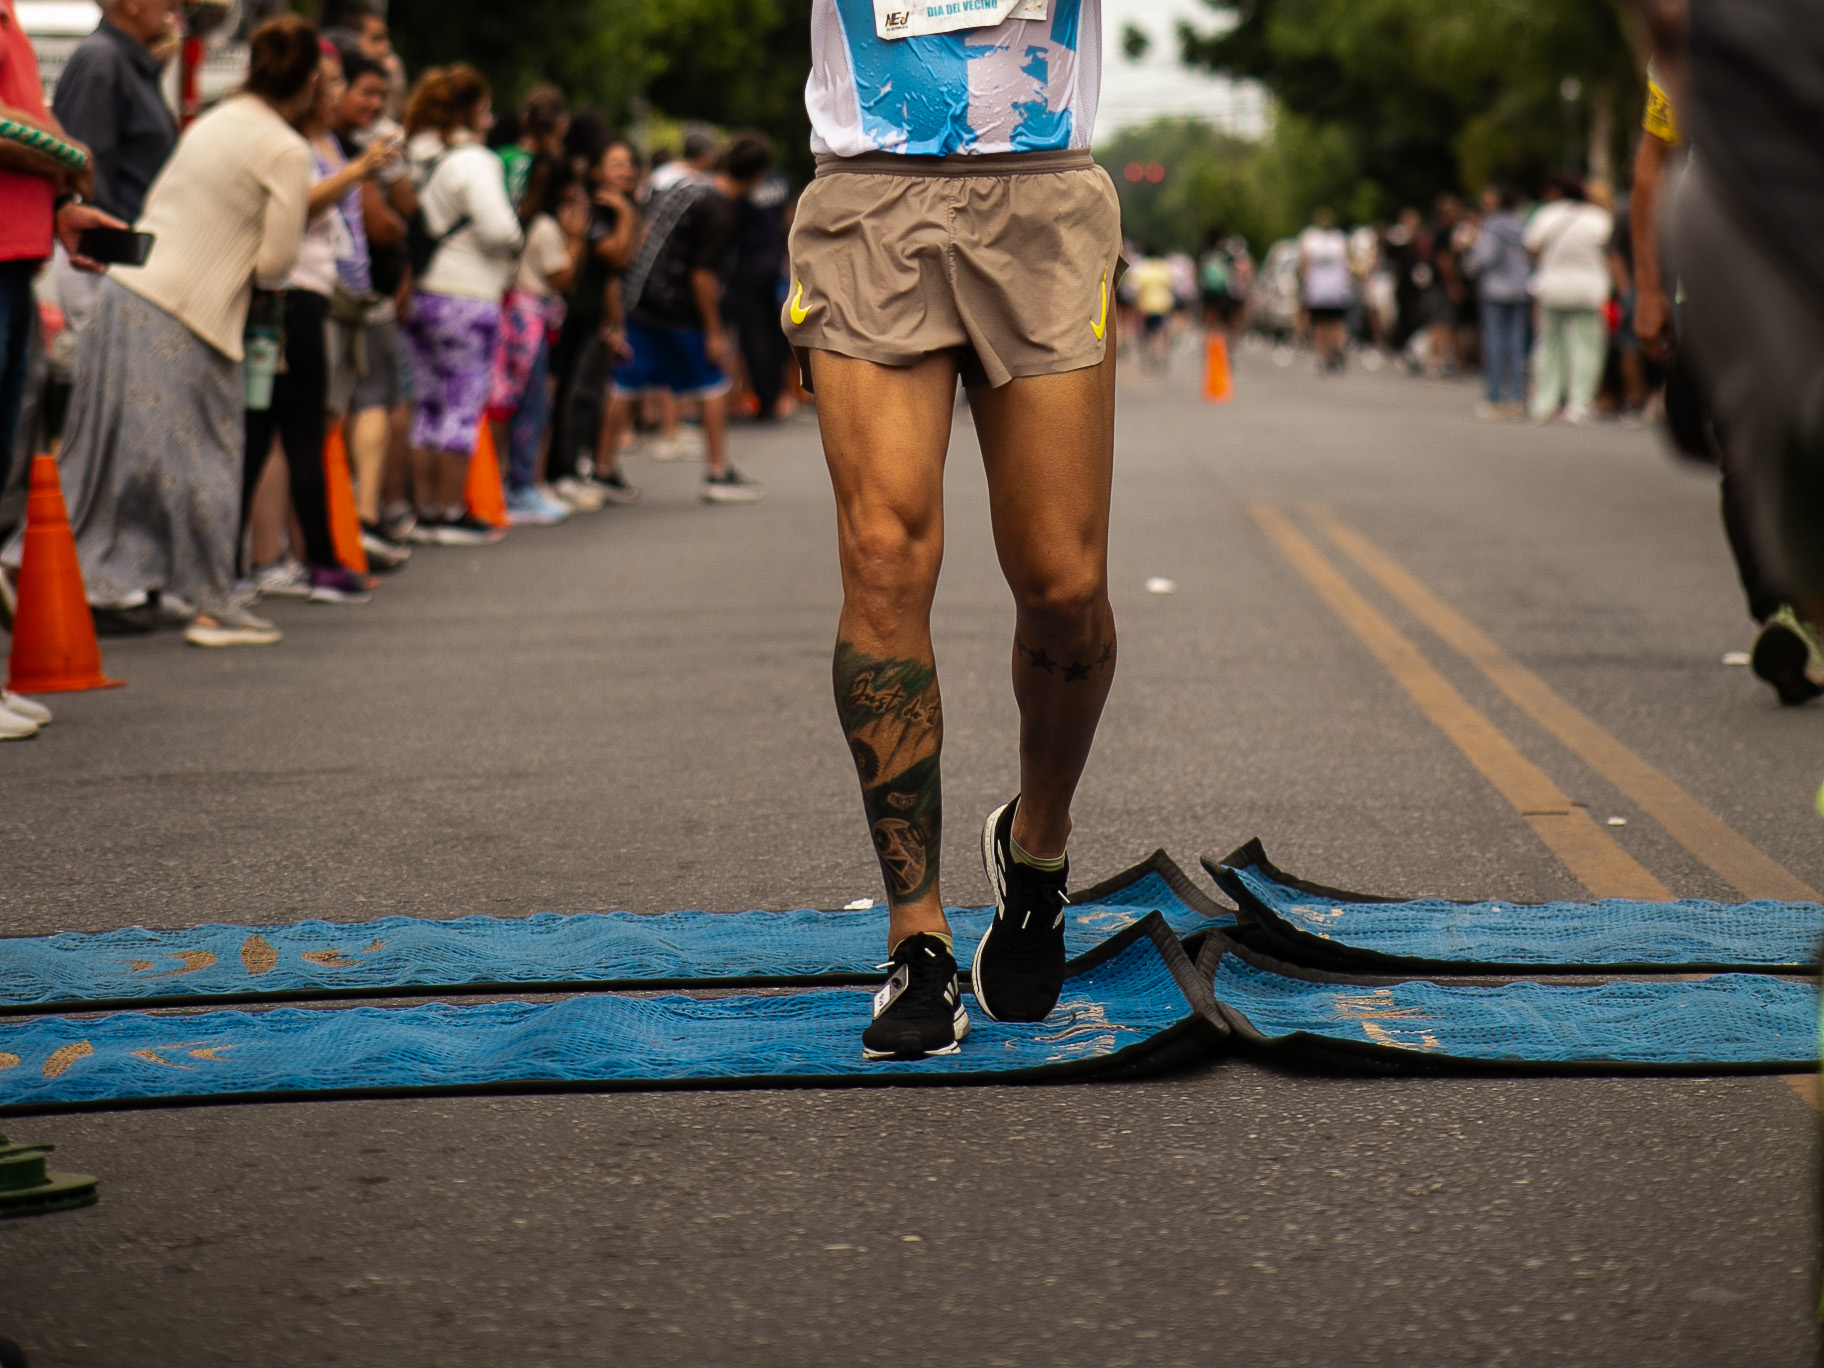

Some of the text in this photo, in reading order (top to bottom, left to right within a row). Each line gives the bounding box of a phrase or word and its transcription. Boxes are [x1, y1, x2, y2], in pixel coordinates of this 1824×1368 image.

[926, 5, 944, 18] DIA
[946, 2, 961, 15] DEL
[849, 676, 941, 725] Just do it
